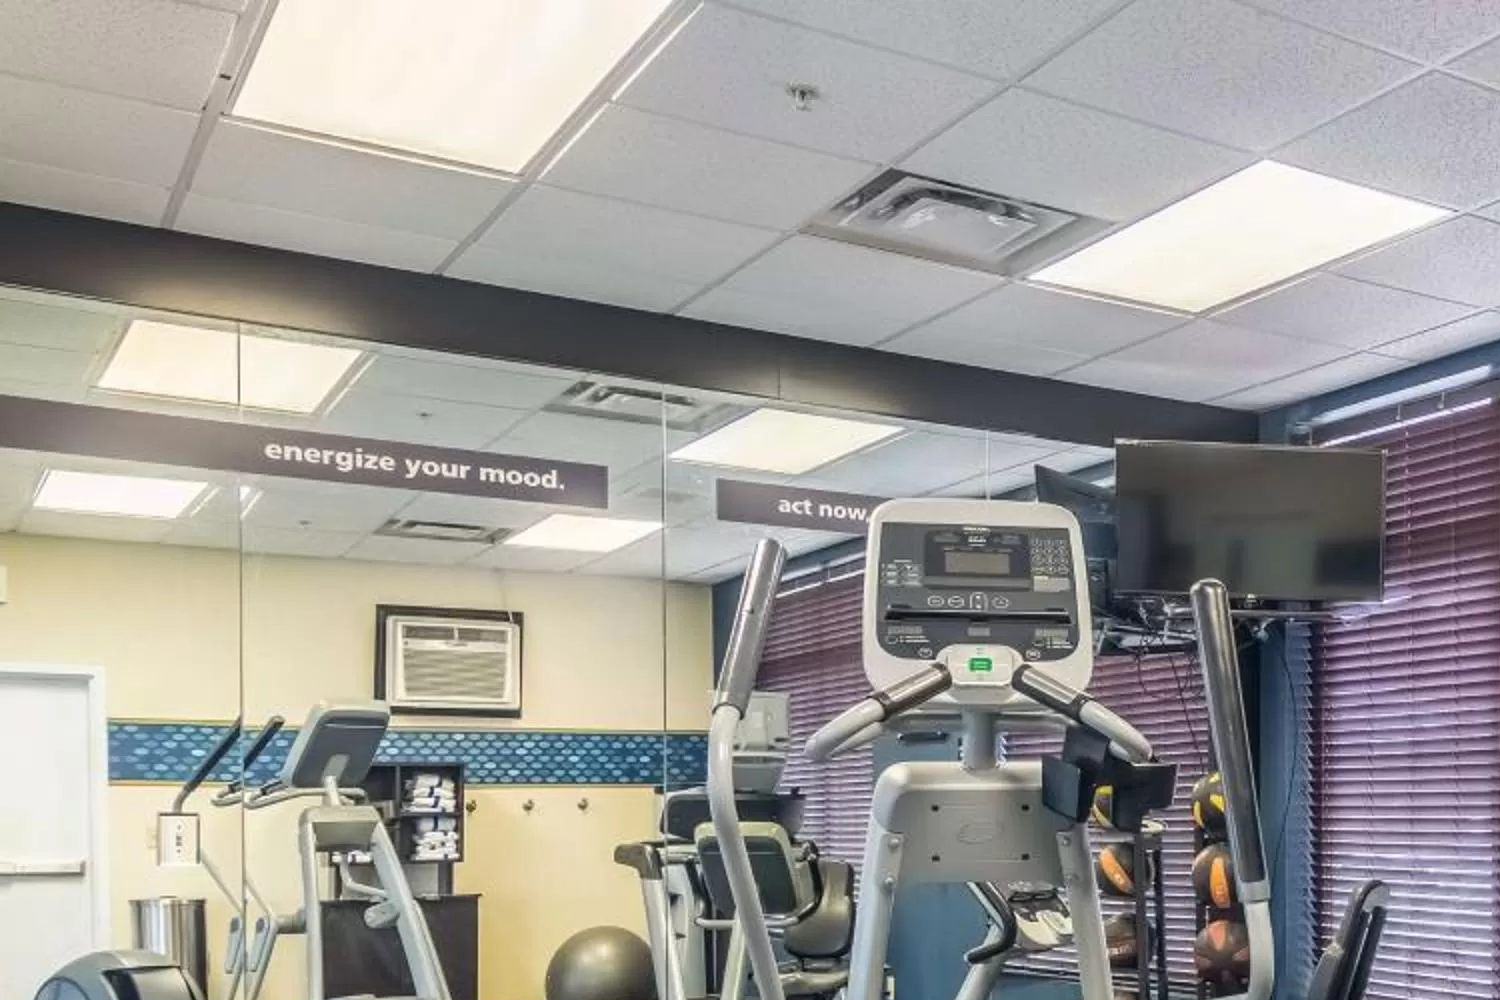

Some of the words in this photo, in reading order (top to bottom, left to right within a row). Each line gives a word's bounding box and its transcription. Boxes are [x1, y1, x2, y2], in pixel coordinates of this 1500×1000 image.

[264, 443, 396, 473] energize
[405, 457, 471, 479] your
[479, 466, 565, 490] mood.
[778, 499, 813, 517] act
